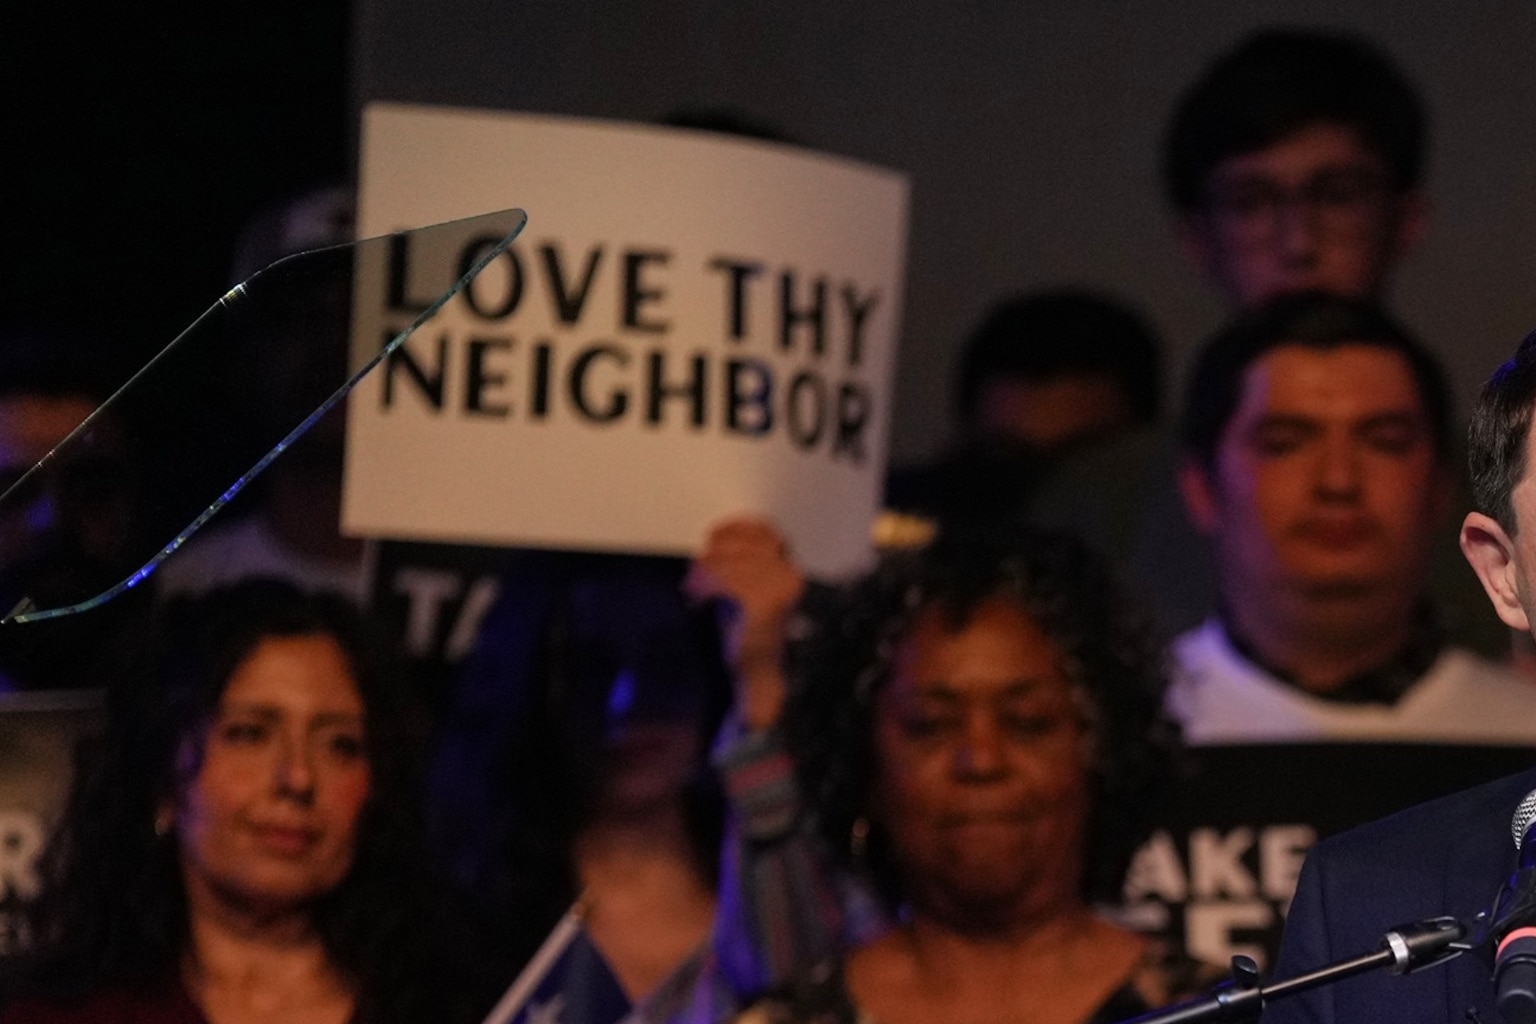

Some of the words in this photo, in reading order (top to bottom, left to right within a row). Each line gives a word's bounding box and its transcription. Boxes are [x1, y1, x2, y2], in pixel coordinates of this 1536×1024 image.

[384, 229, 673, 337] LOVE
[707, 254, 880, 369] THY
[377, 326, 873, 466] NEIGHBOR
[1120, 820, 1317, 902] AKE
